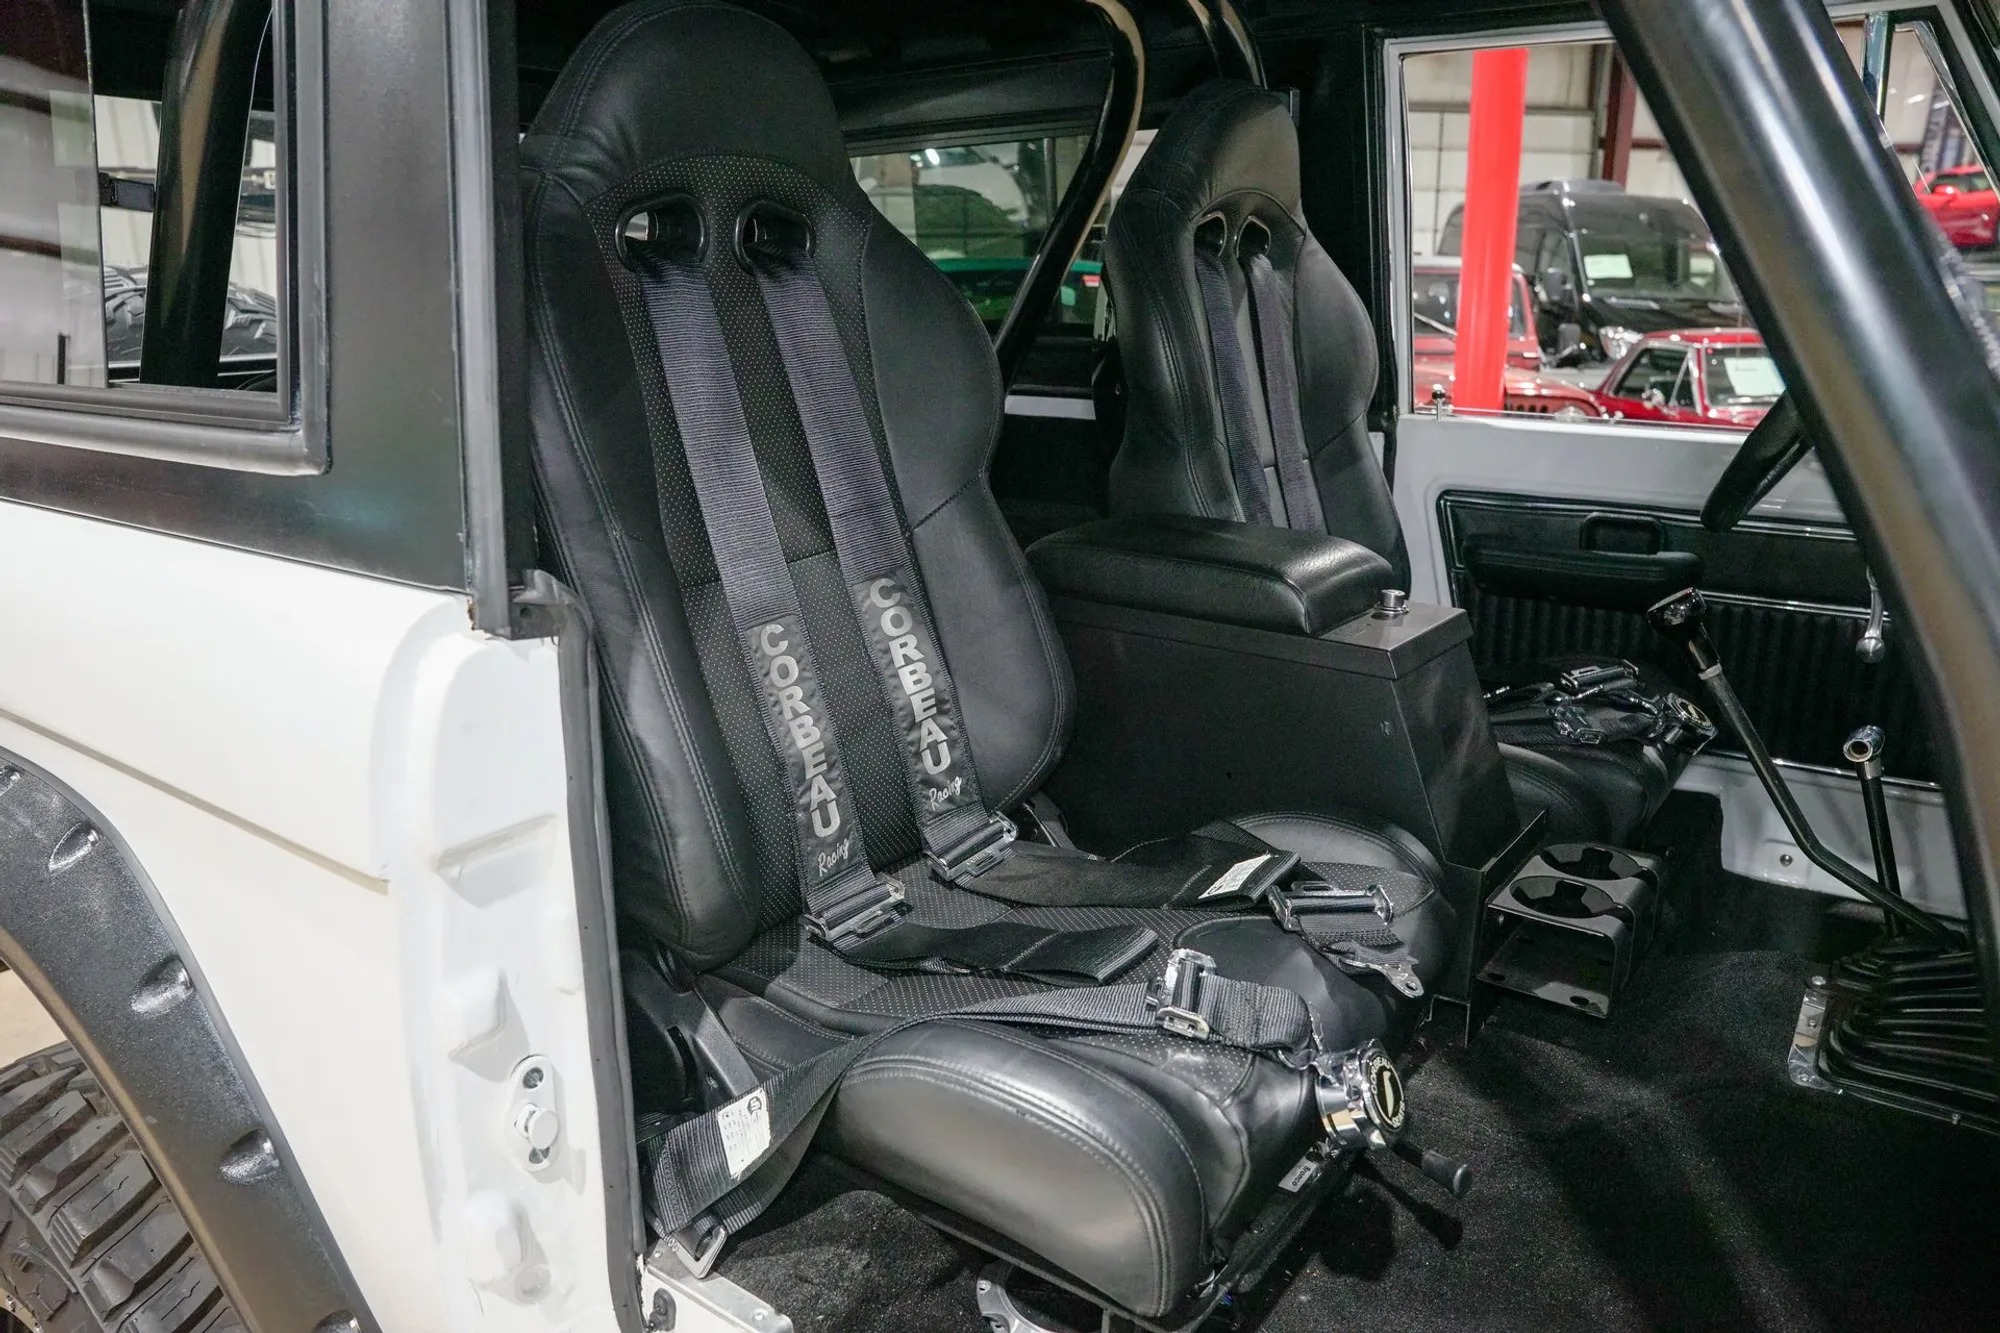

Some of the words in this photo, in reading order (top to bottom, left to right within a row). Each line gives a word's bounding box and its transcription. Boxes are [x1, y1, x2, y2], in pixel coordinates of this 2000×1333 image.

[869, 578, 951, 775] CORBEAU
[760, 624, 840, 838] CORBEAU
[929, 775, 963, 811] Racing
[818, 838, 850, 877] Racing
[1291, 1165, 1311, 1186] Bronco
